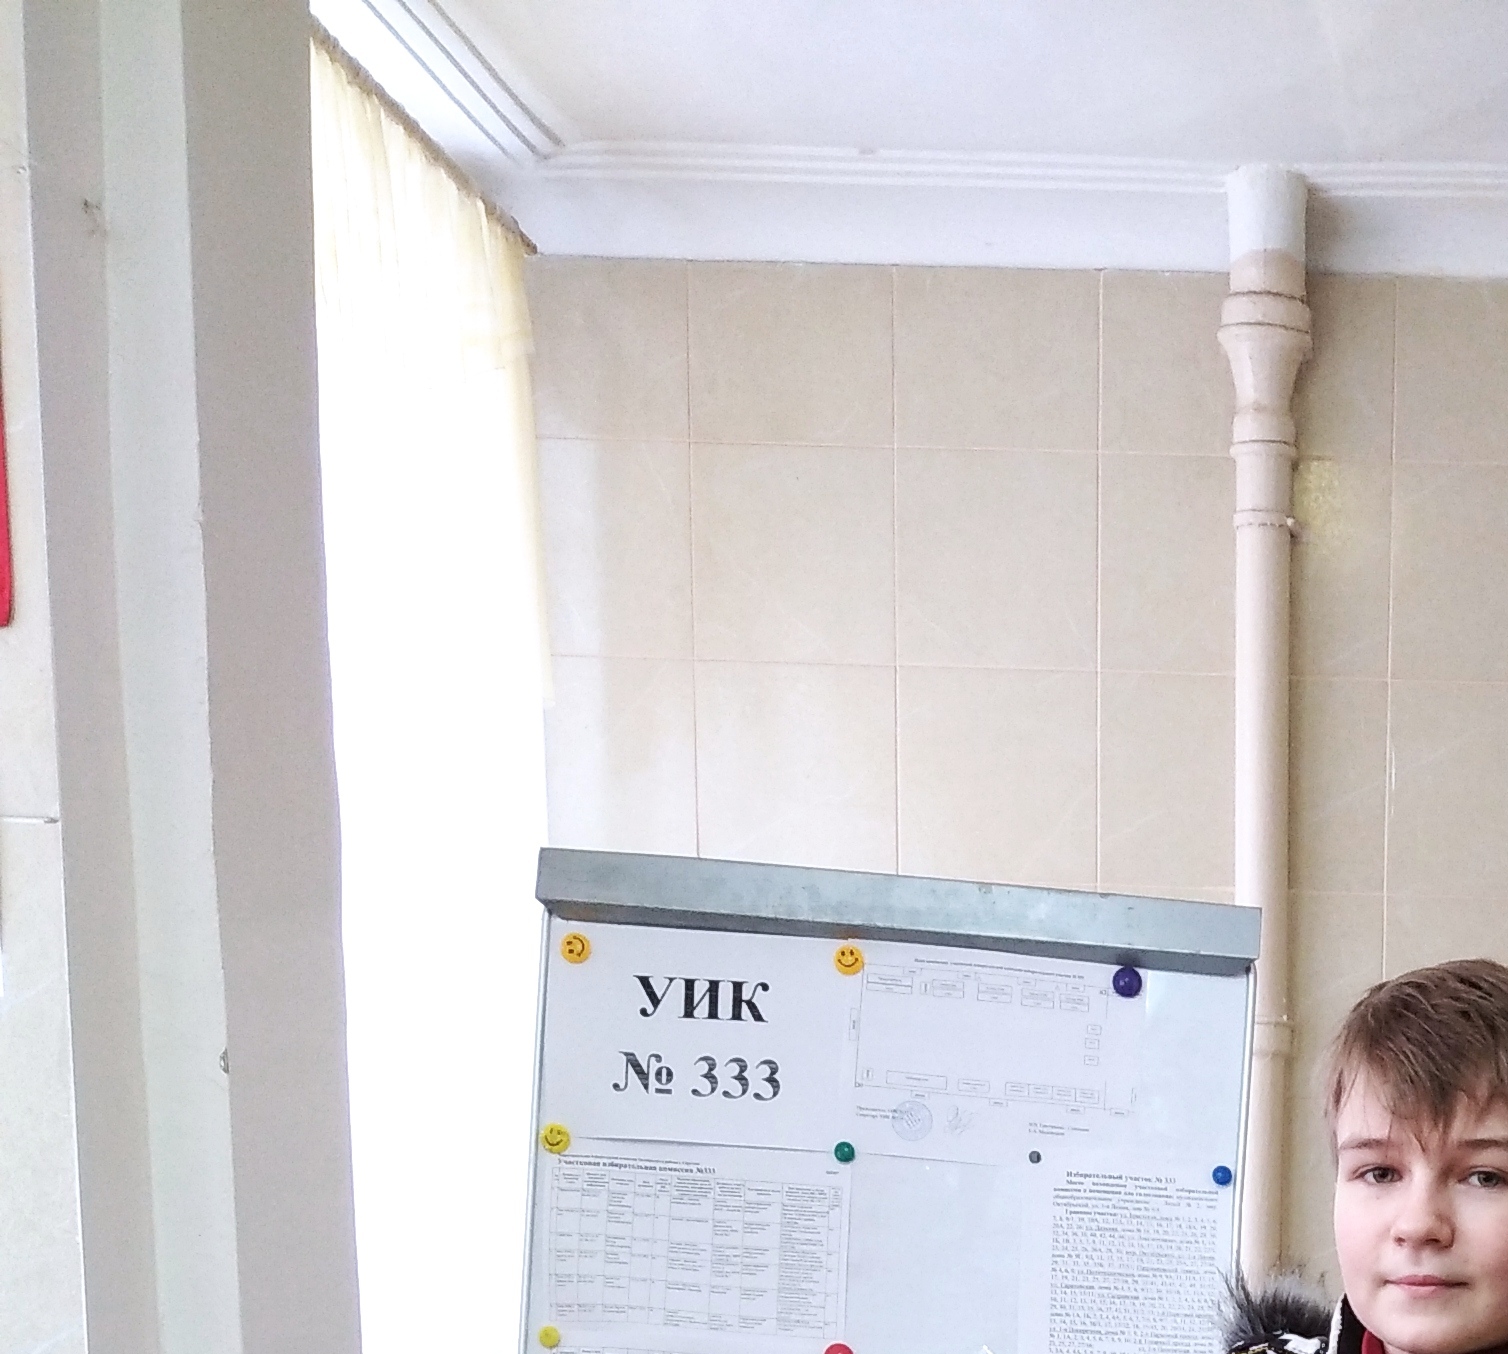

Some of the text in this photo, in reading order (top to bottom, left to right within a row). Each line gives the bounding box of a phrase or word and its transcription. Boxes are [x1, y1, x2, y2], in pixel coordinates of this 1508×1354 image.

[633, 975, 770, 1023] УИК
[612, 1050, 781, 1102] № 333
